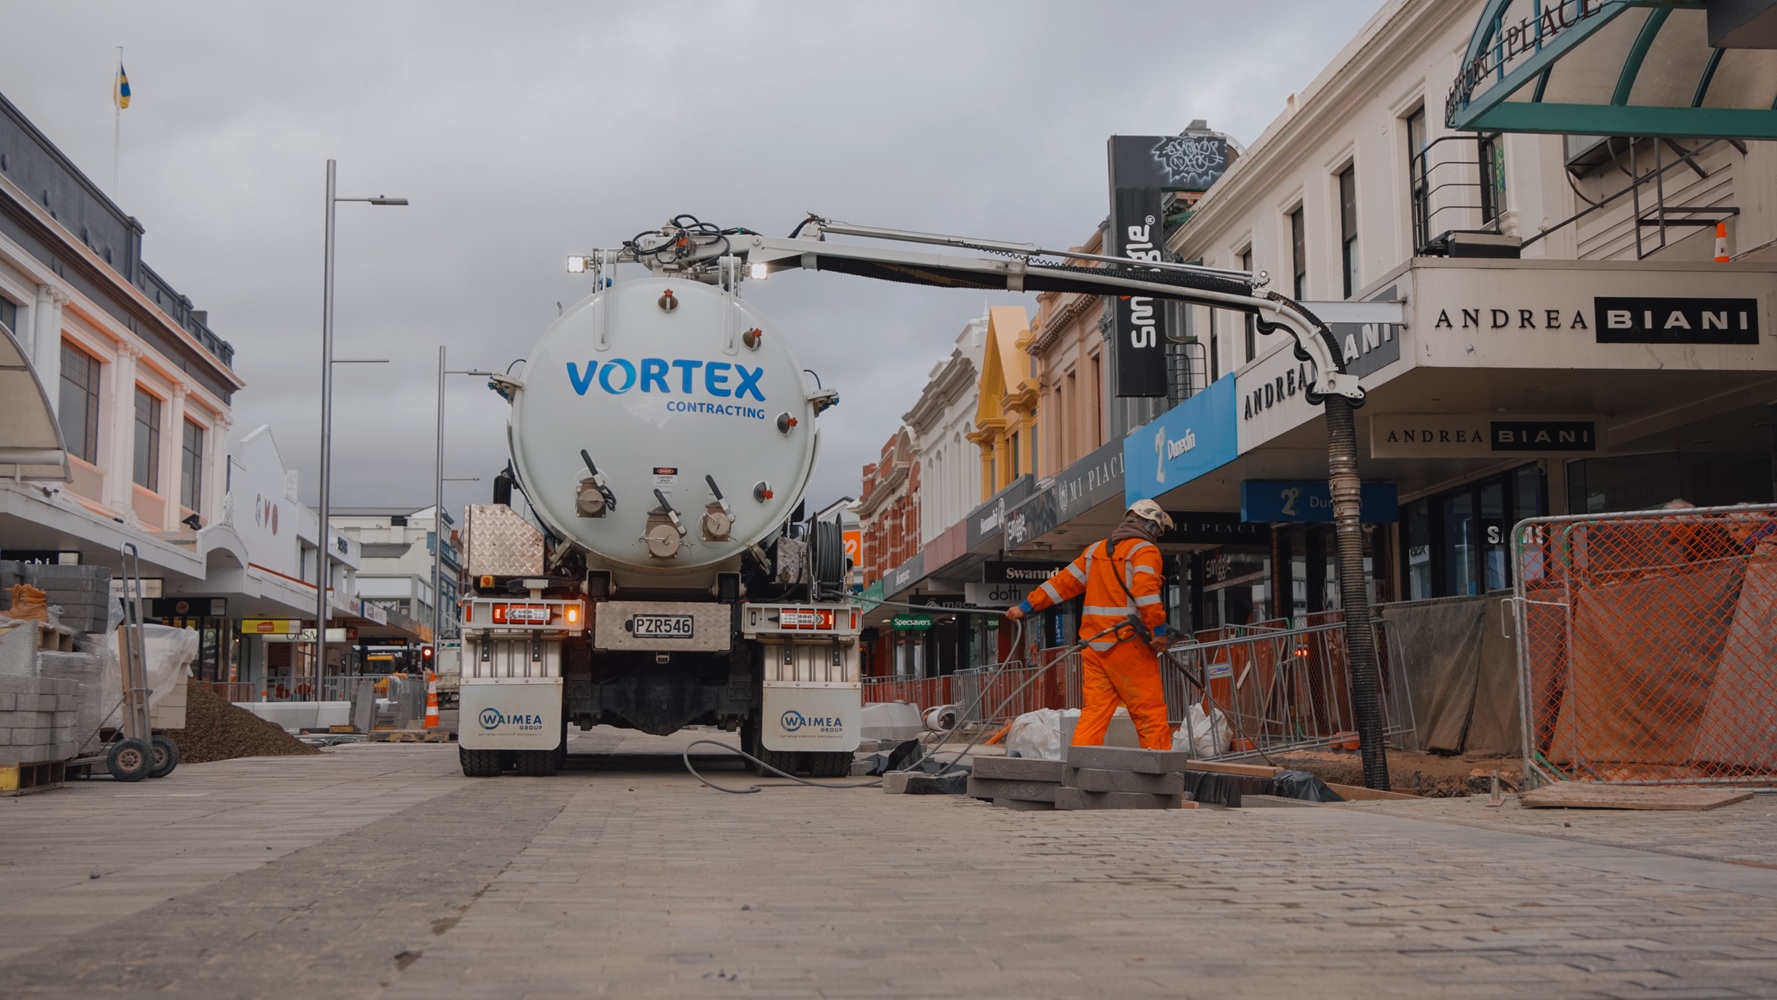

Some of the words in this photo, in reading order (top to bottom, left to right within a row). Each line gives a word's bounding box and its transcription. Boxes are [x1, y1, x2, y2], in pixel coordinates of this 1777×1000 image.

[1506, 0, 1600, 63] PLACE
[1435, 308, 1588, 329] ANDREA
[1607, 310, 1748, 330] BIANI
[566, 358, 766, 402] VORTEX
[1244, 363, 1307, 421] ANDREA
[666, 401, 766, 420] CONTRACTING
[1387, 429, 1483, 443] ANDREA
[1498, 429, 1588, 443] BIANI
[1069, 477, 1083, 502] MI
[1088, 452, 1124, 491] PIACI
[1201, 523, 1255, 533] PIACI
[989, 585, 1022, 601] dotti
[636, 619, 690, 633] PZR546
[894, 618, 931, 626] Specsavers
[483, 715, 542, 724] WAIMEA
[785, 717, 842, 726] WAIMEA
